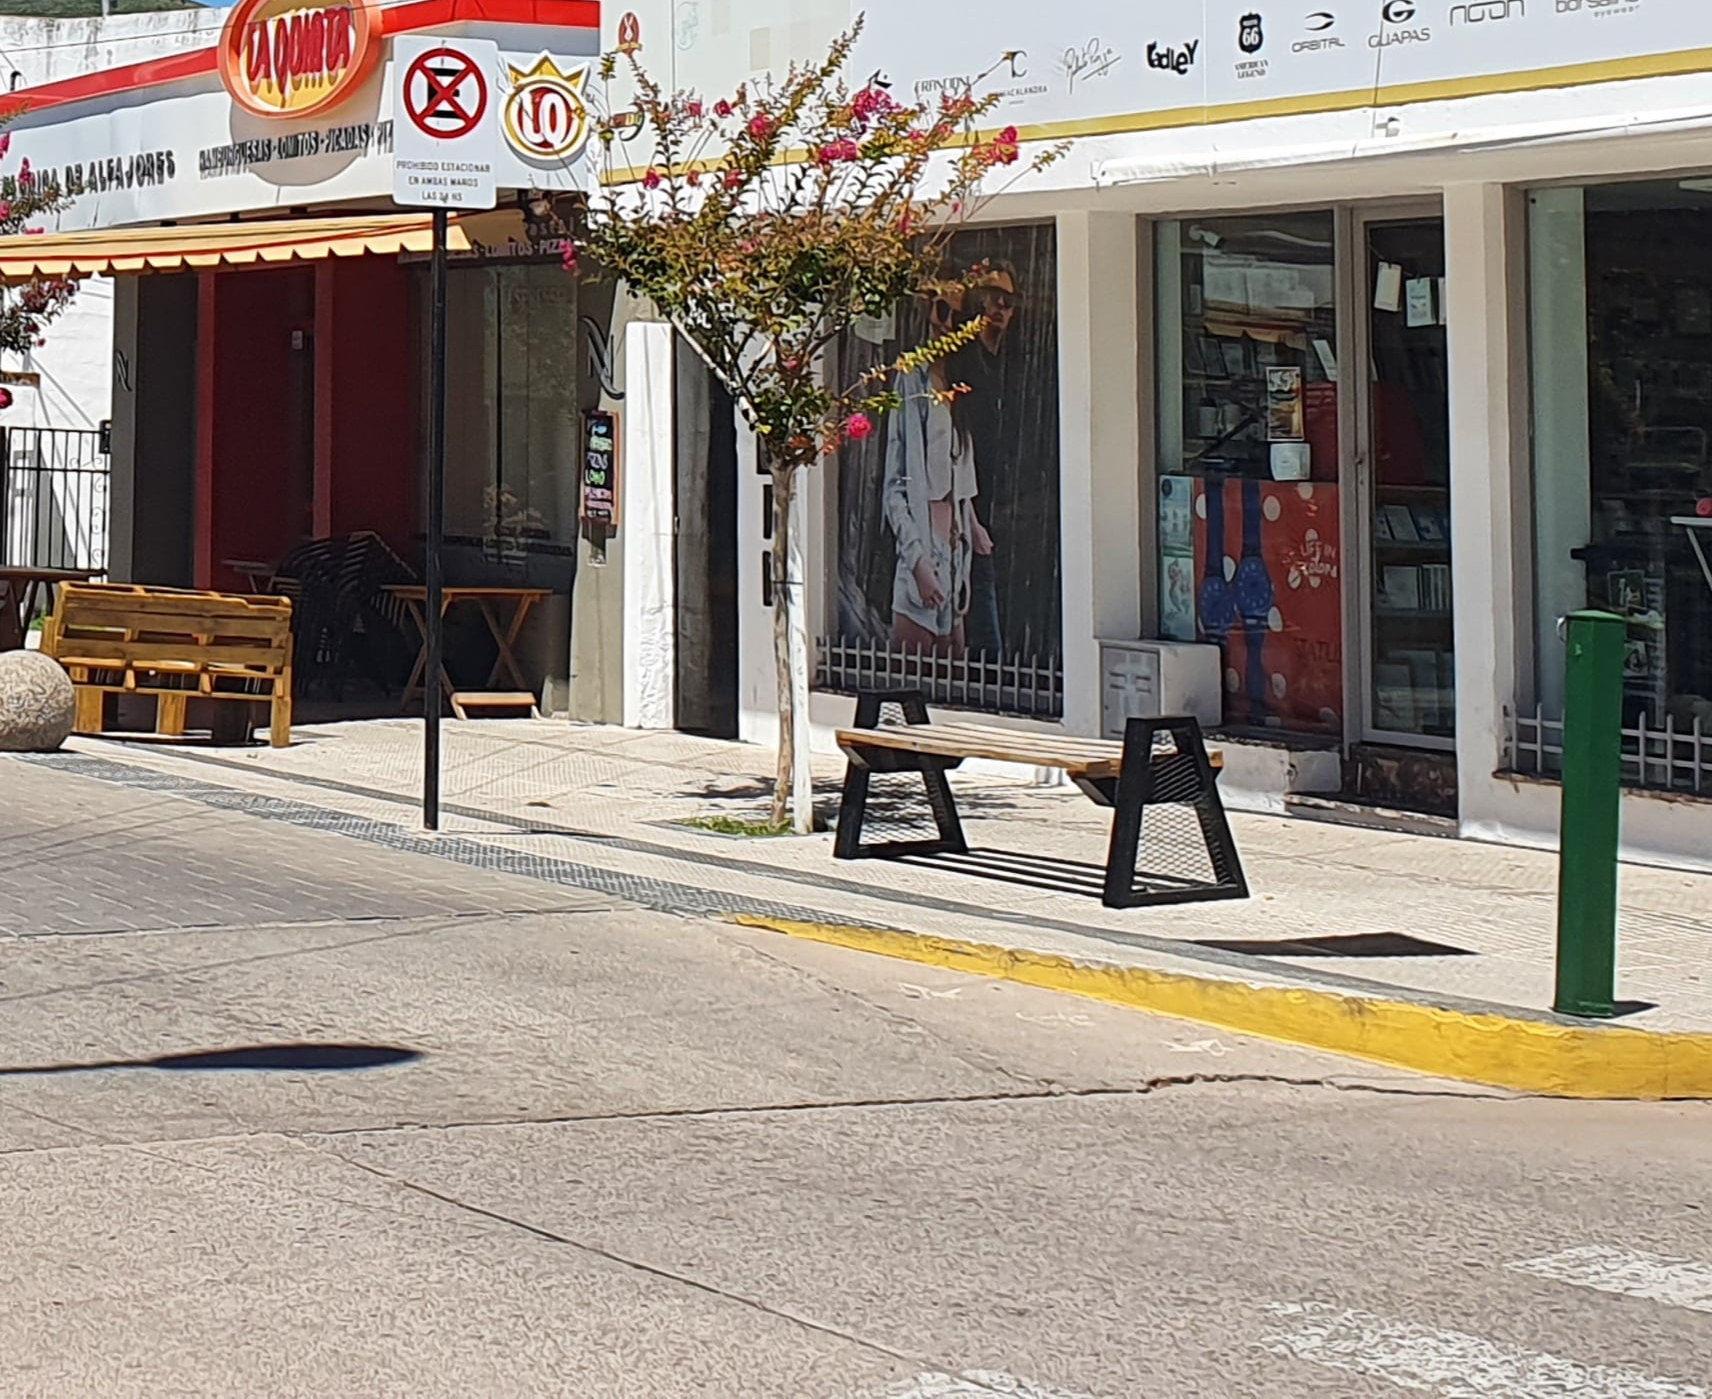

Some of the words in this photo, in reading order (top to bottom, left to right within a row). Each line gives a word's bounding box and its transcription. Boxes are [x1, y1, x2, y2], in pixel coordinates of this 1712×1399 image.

[1242, 27, 1260, 46] 66
[87, 149, 176, 194] ALFAJORES
[396, 160, 439, 171] PROHIBIDO
[441, 162, 491, 173] ESTACIONAR
[408, 176, 420, 186] EN
[421, 191, 438, 201] LAS
